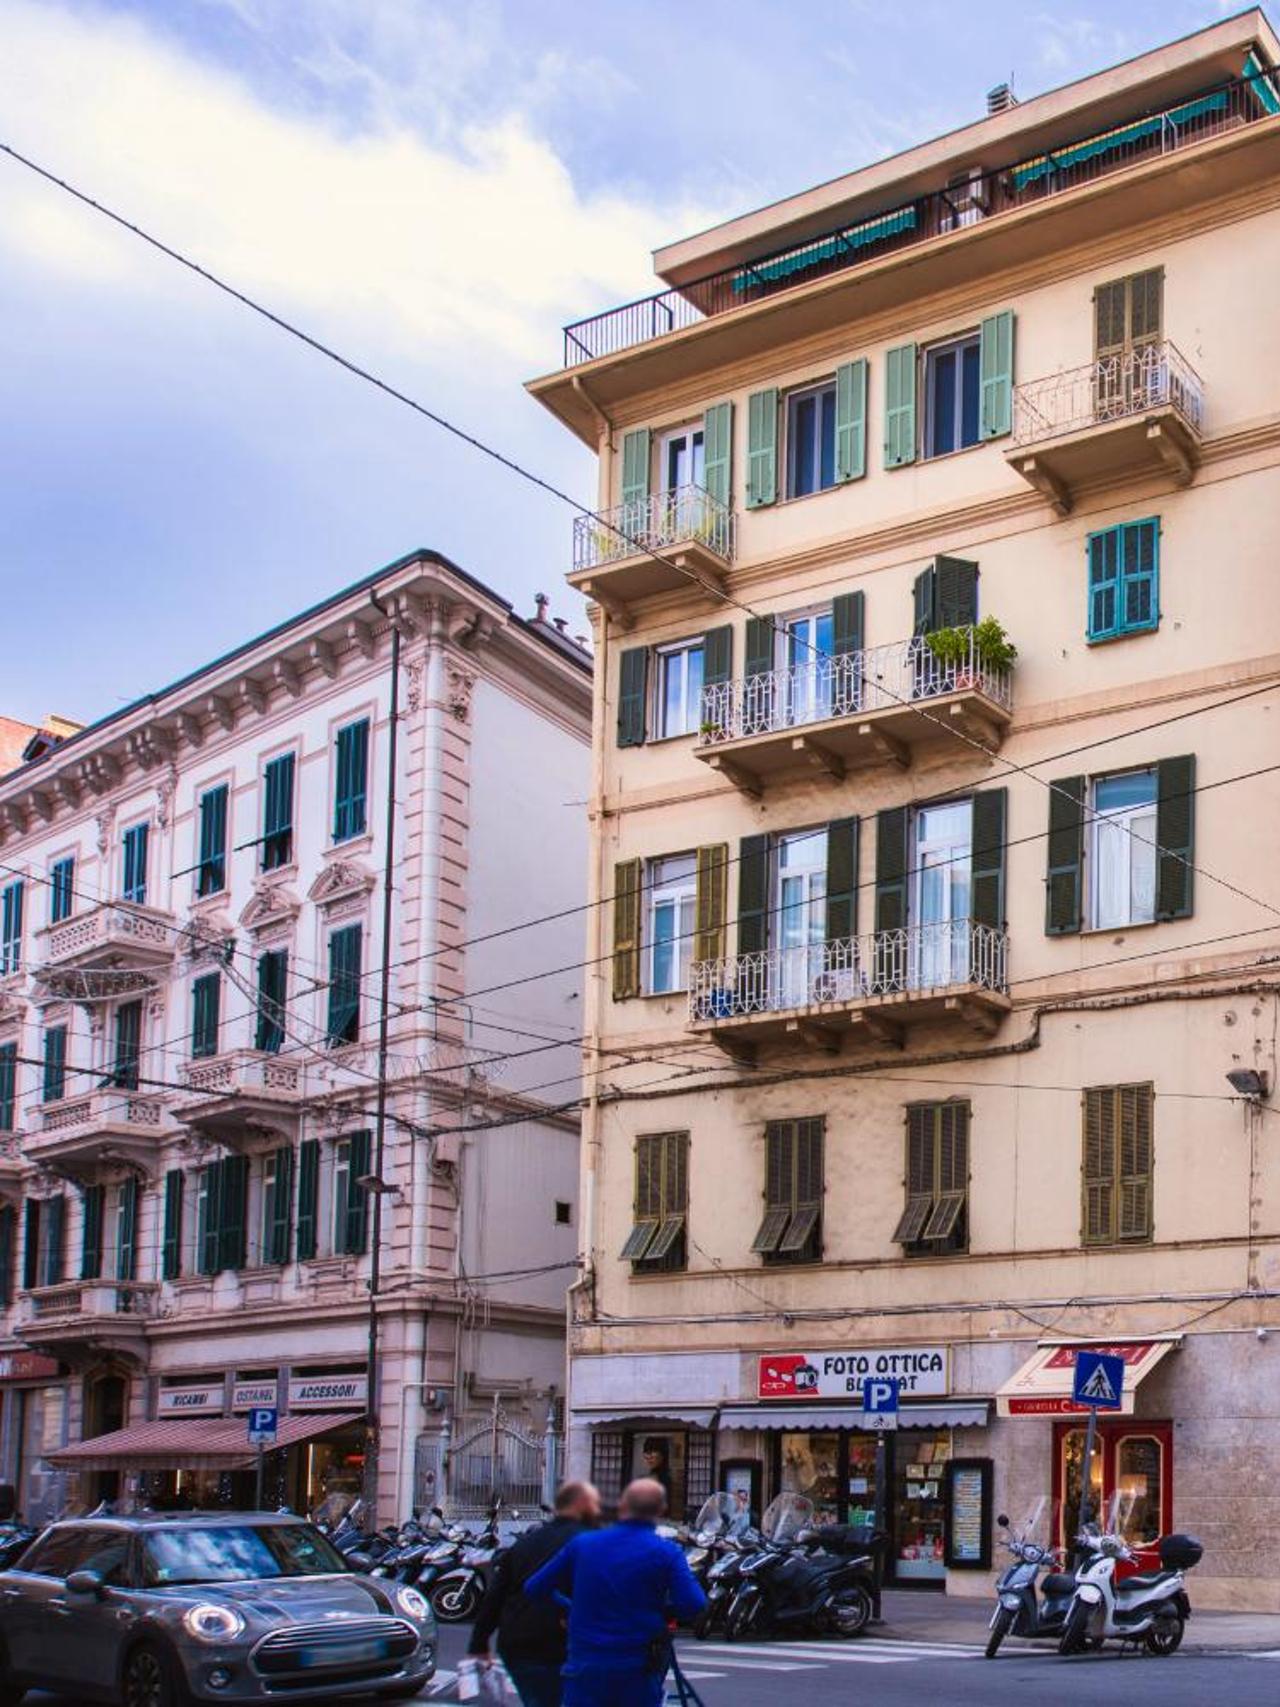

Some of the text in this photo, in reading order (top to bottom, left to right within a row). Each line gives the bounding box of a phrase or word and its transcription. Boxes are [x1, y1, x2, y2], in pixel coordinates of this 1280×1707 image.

[823, 1353, 943, 1375] FOTO OTTICA
[298, 1383, 358, 1400] ACCESSORI
[846, 1375, 918, 1392] BLAT
[870, 1384, 892, 1409] P
[254, 1411, 272, 1429] P
